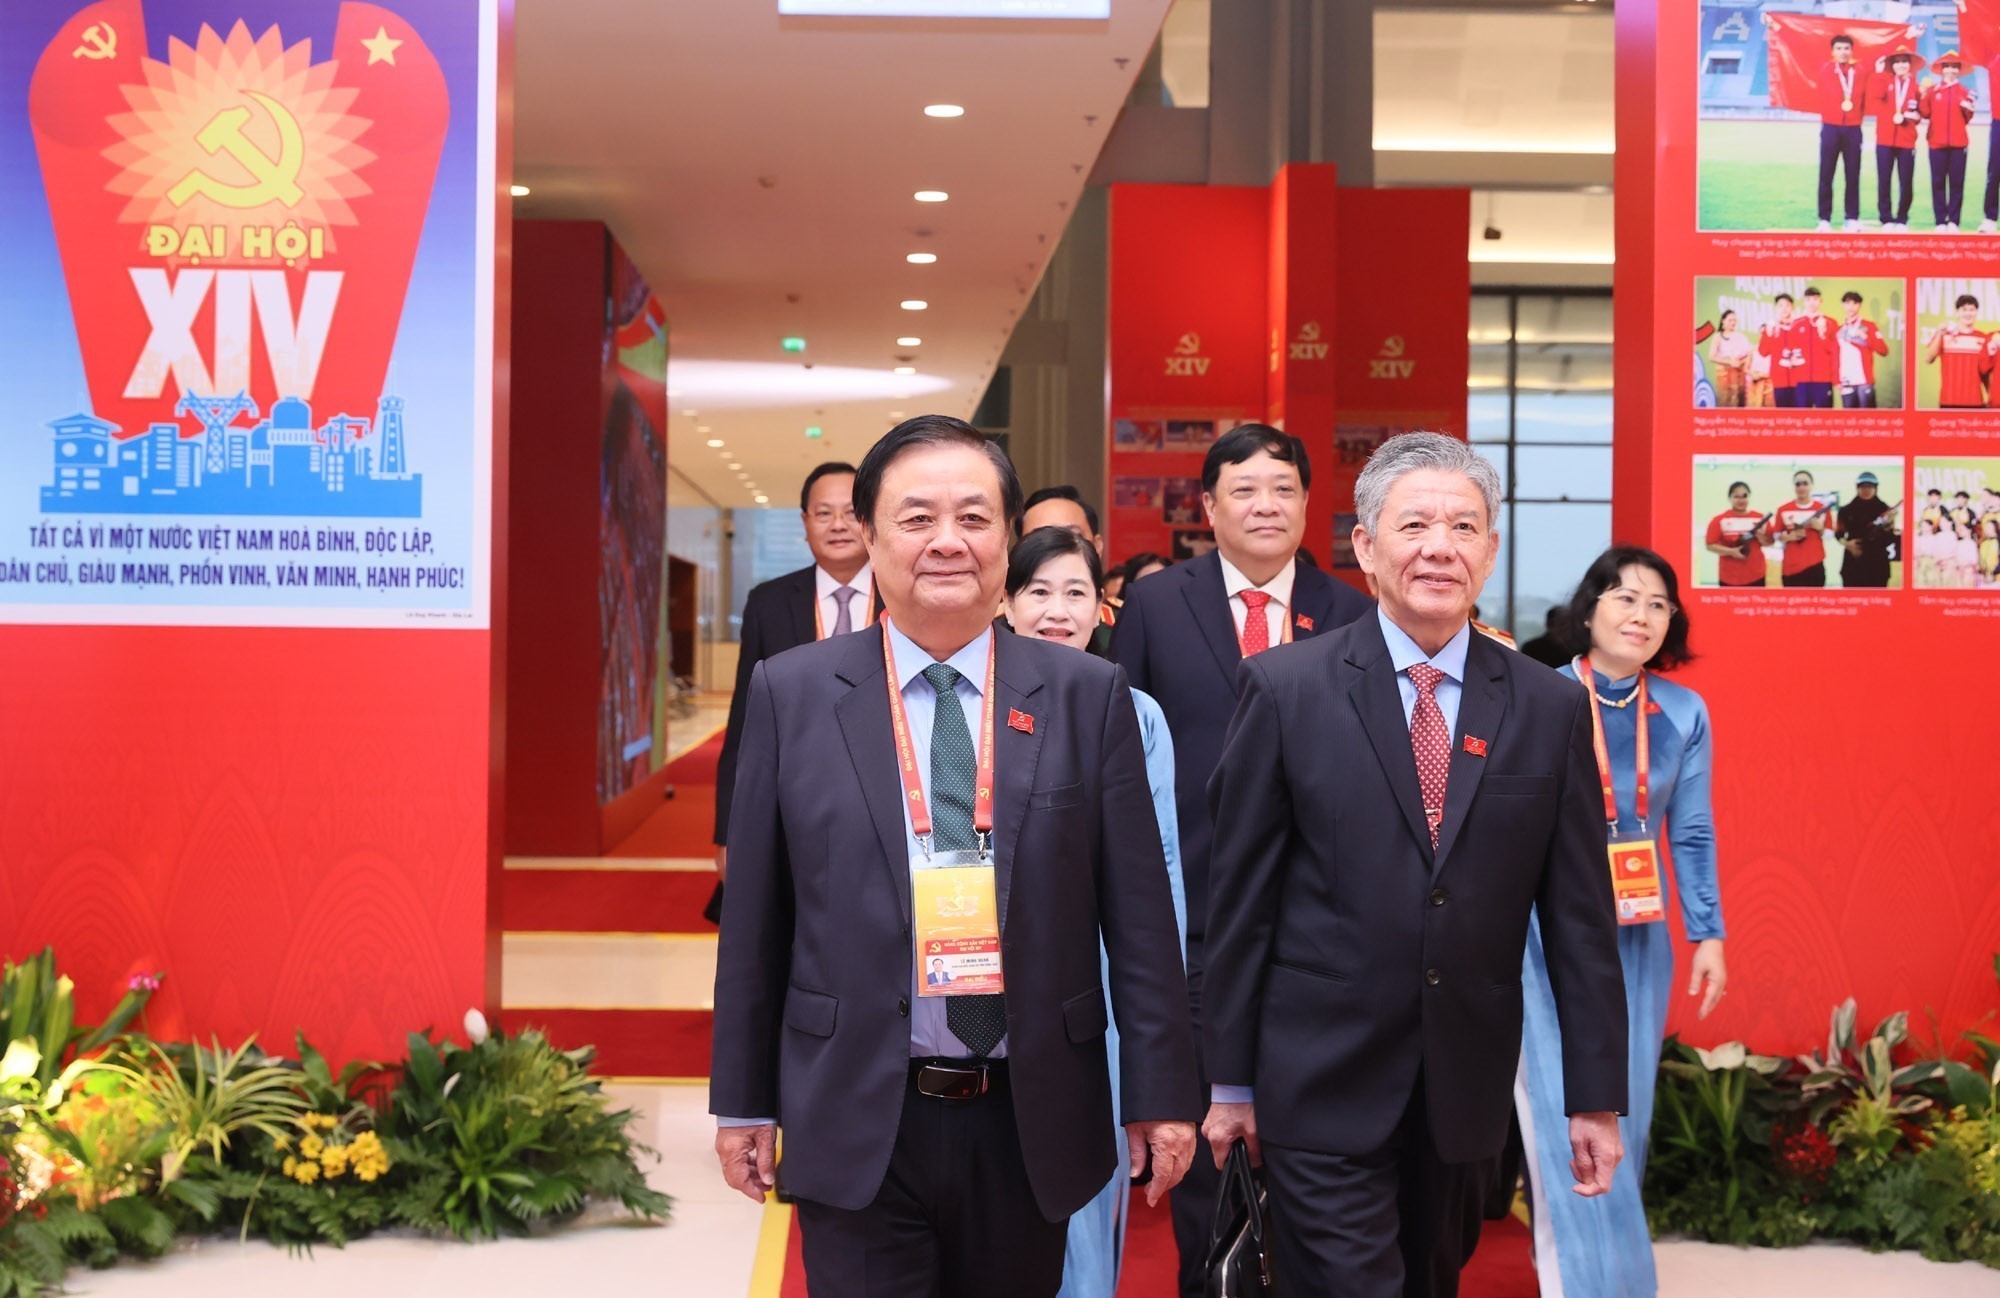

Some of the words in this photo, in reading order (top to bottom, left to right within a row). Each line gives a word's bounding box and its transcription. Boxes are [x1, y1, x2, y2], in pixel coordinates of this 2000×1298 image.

[146, 224, 226, 266] ĐẠI
[241, 219, 325, 268] HỘI
[122, 267, 345, 401] XIV
[1290, 343, 1329, 361] XIV
[1164, 356, 1211, 376] XIV
[1369, 360, 1415, 380] XIV
[29, 517, 58, 548] TẤT
[62, 519, 84, 549] CẢ
[89, 521, 104, 549] VÌ
[109, 522, 144, 555] MỘT
[148, 523, 192, 550] NƯỚC
[197, 523, 230, 556] VIỆT
[236, 529, 273, 551] NAM
[279, 525, 311, 552] HOÀ
[317, 525, 360, 554] BÌNH,
[365, 526, 397, 558] ĐỘC
[402, 527, 434, 558] LẬP,
[36, 555, 73, 586] CHỦ,
[78, 557, 116, 584] GIÀU
[121, 562, 175, 590] MẠNH,
[228, 564, 271, 590] VINH,
[276, 560, 308, 587] VĂN
[313, 565, 362, 590] MINH,
[366, 566, 411, 593] HẠNH
[415, 562, 465, 590] PHÚC!
